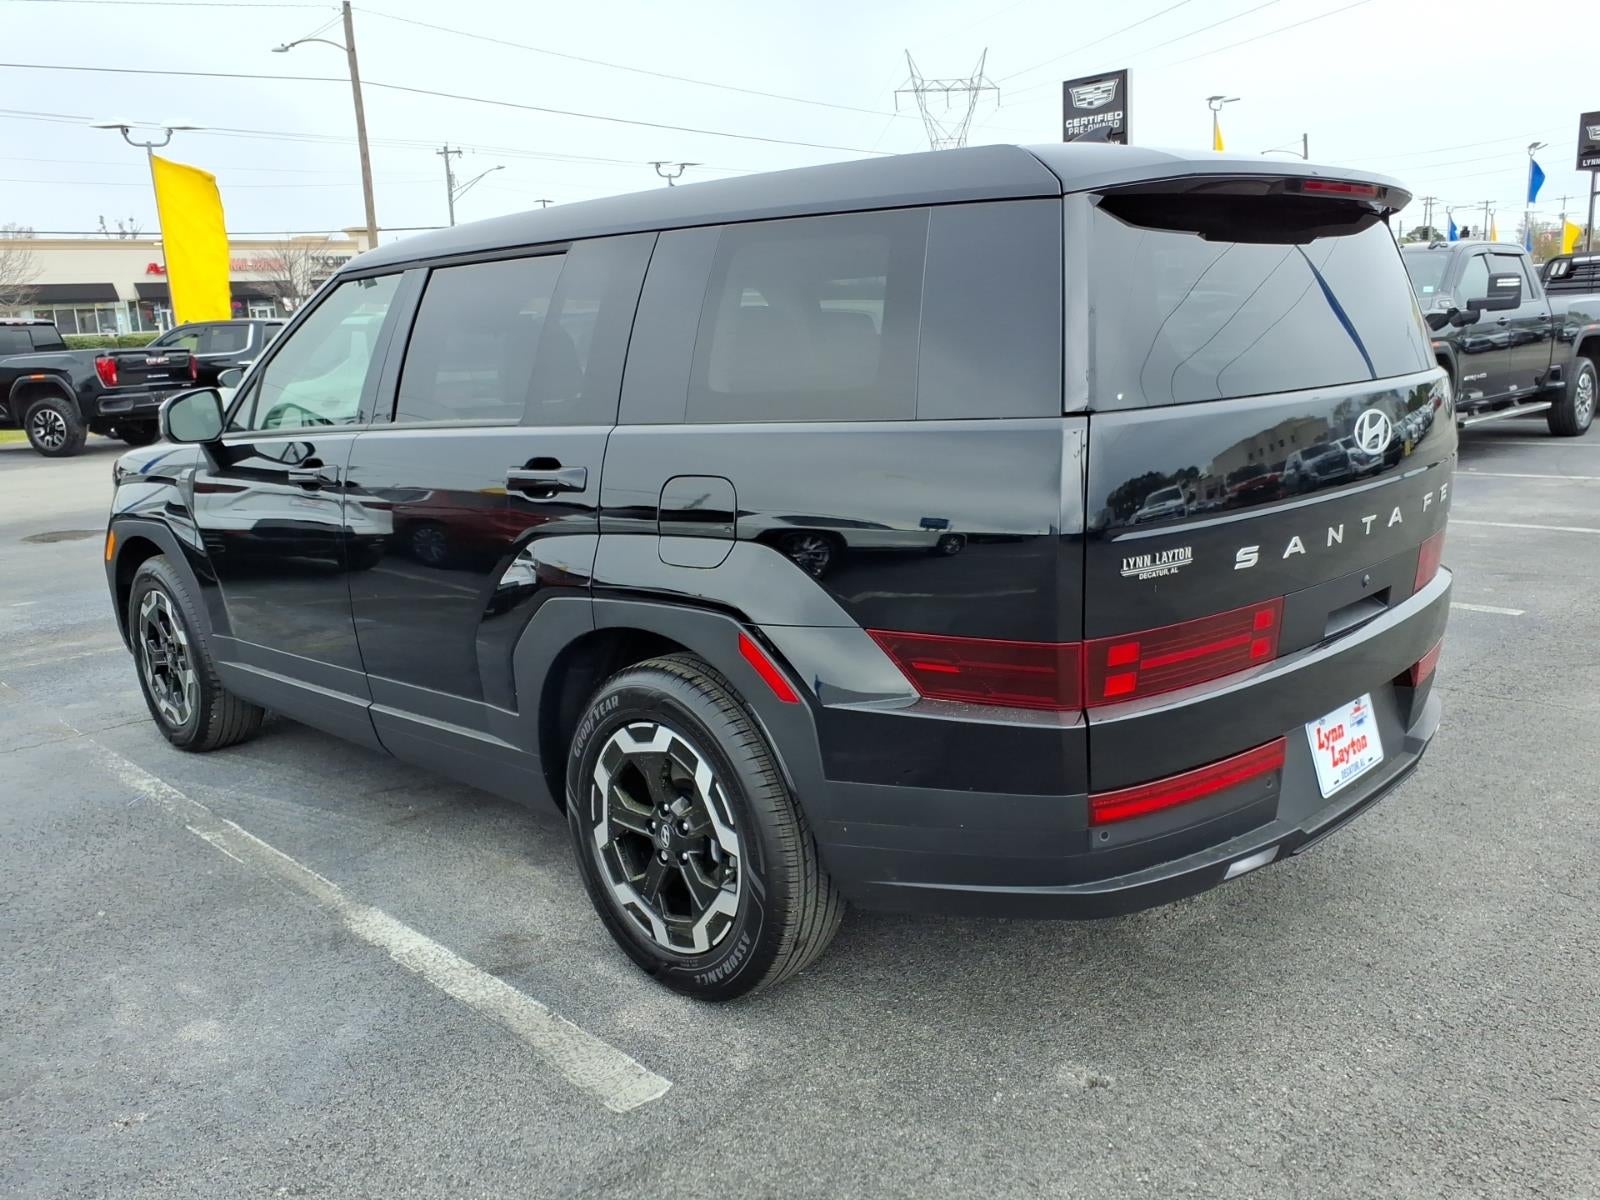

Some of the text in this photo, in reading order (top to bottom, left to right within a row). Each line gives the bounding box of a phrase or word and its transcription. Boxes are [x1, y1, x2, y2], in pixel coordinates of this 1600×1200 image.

[1066, 111, 1123, 127] CERTIFIED
[1234, 483, 1448, 570] SANTA FE
[1122, 546, 1192, 571] LYNN LAYTON
[574, 695, 619, 758] GOODYEAR
[1316, 724, 1344, 751] Lynn
[1331, 735, 1368, 768] Layton
[694, 930, 751, 985] ASSURANCE
